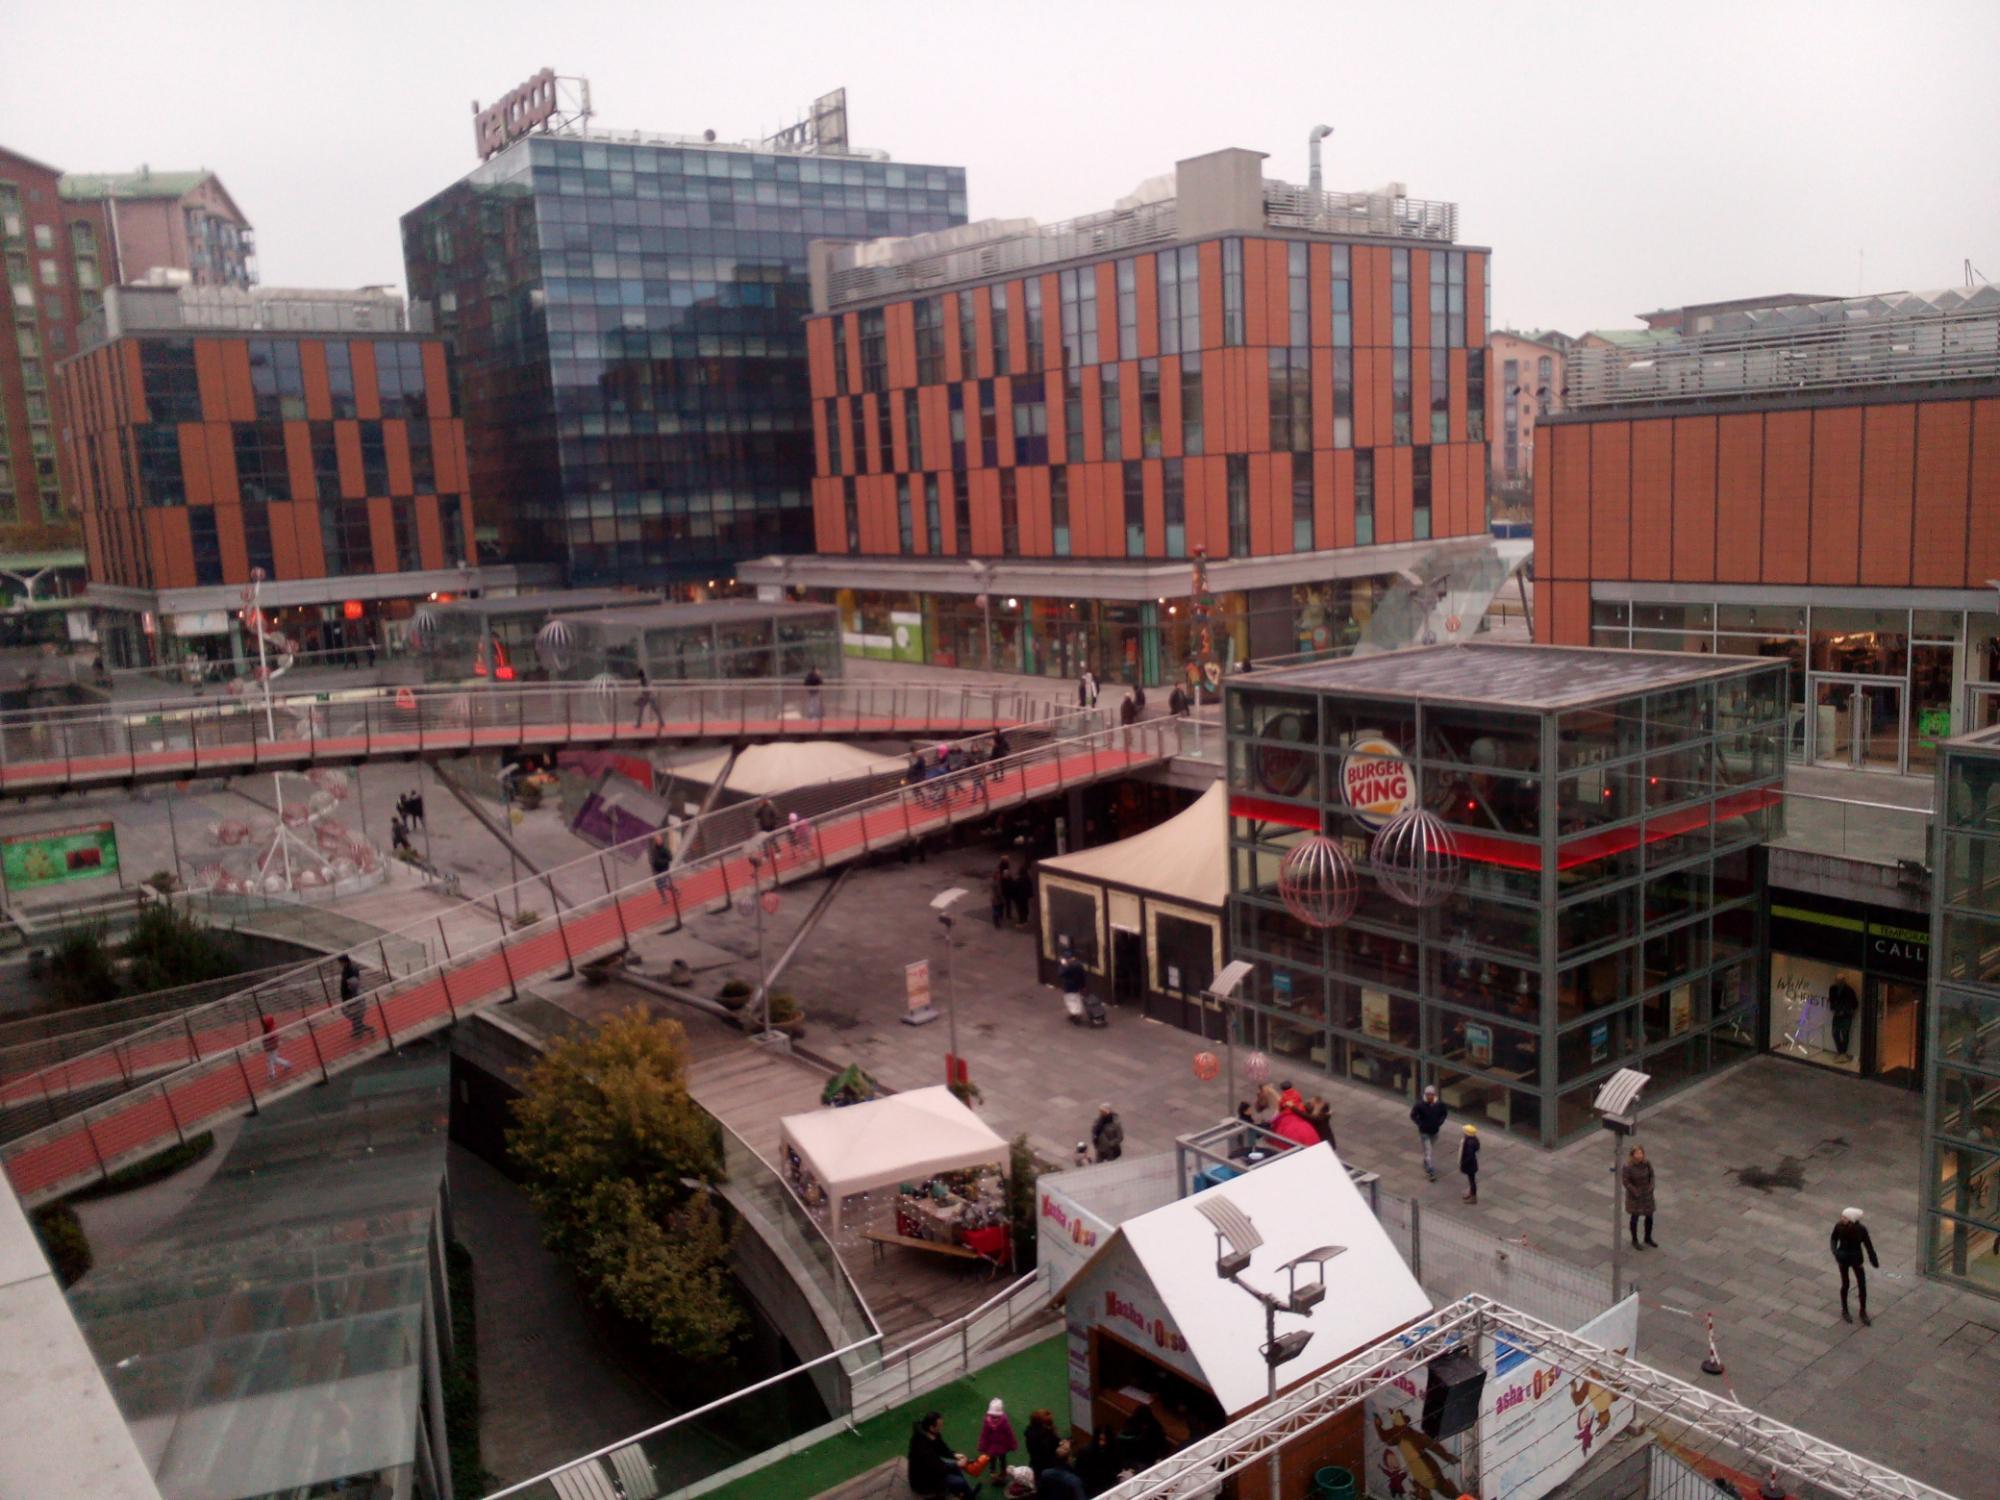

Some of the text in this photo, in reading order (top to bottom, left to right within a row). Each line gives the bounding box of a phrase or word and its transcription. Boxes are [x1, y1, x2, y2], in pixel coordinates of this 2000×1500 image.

[1347, 760, 1404, 785] BURGER
[1351, 776, 1407, 808] KING
[1105, 1290, 1145, 1330] Masha
[1155, 1318, 1187, 1353] Orso
